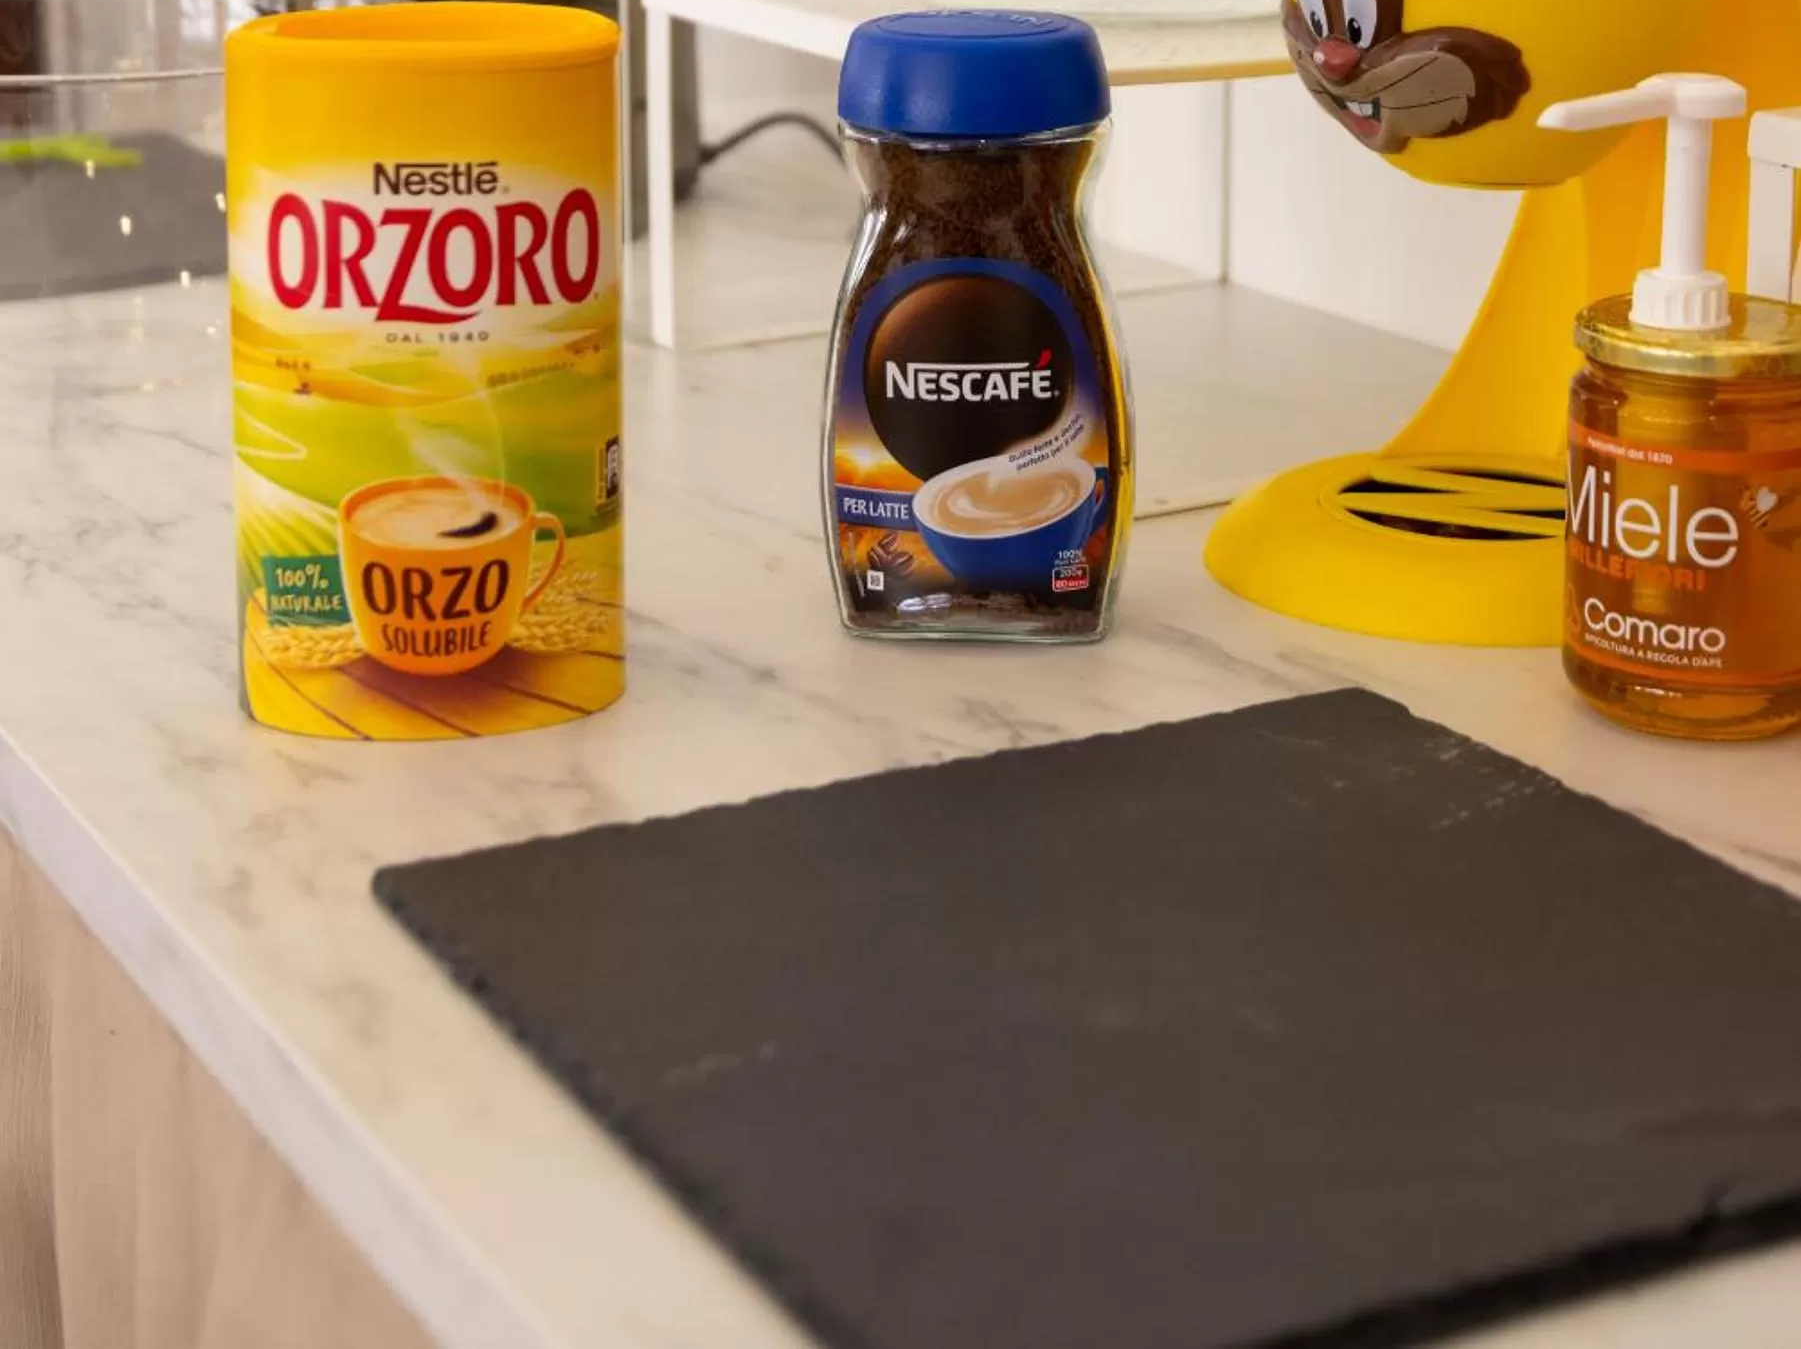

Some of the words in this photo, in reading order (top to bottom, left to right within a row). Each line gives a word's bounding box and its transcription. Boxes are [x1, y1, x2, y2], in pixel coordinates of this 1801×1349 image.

[373, 161, 498, 196] Nestlé
[266, 187, 600, 325] ORZORO
[385, 332, 424, 344] DAL
[437, 330, 490, 343] 1940
[884, 347, 1053, 402] NESCAFÉ
[843, 496, 867, 518] PER
[869, 497, 910, 520] LATTE
[1566, 452, 1740, 569] Miele
[275, 563, 329, 590] 100%
[361, 558, 510, 622] ORZO
[271, 594, 344, 613] NATURALE
[381, 620, 490, 659] SOLUBILE
[1584, 596, 1727, 653] Comaro
